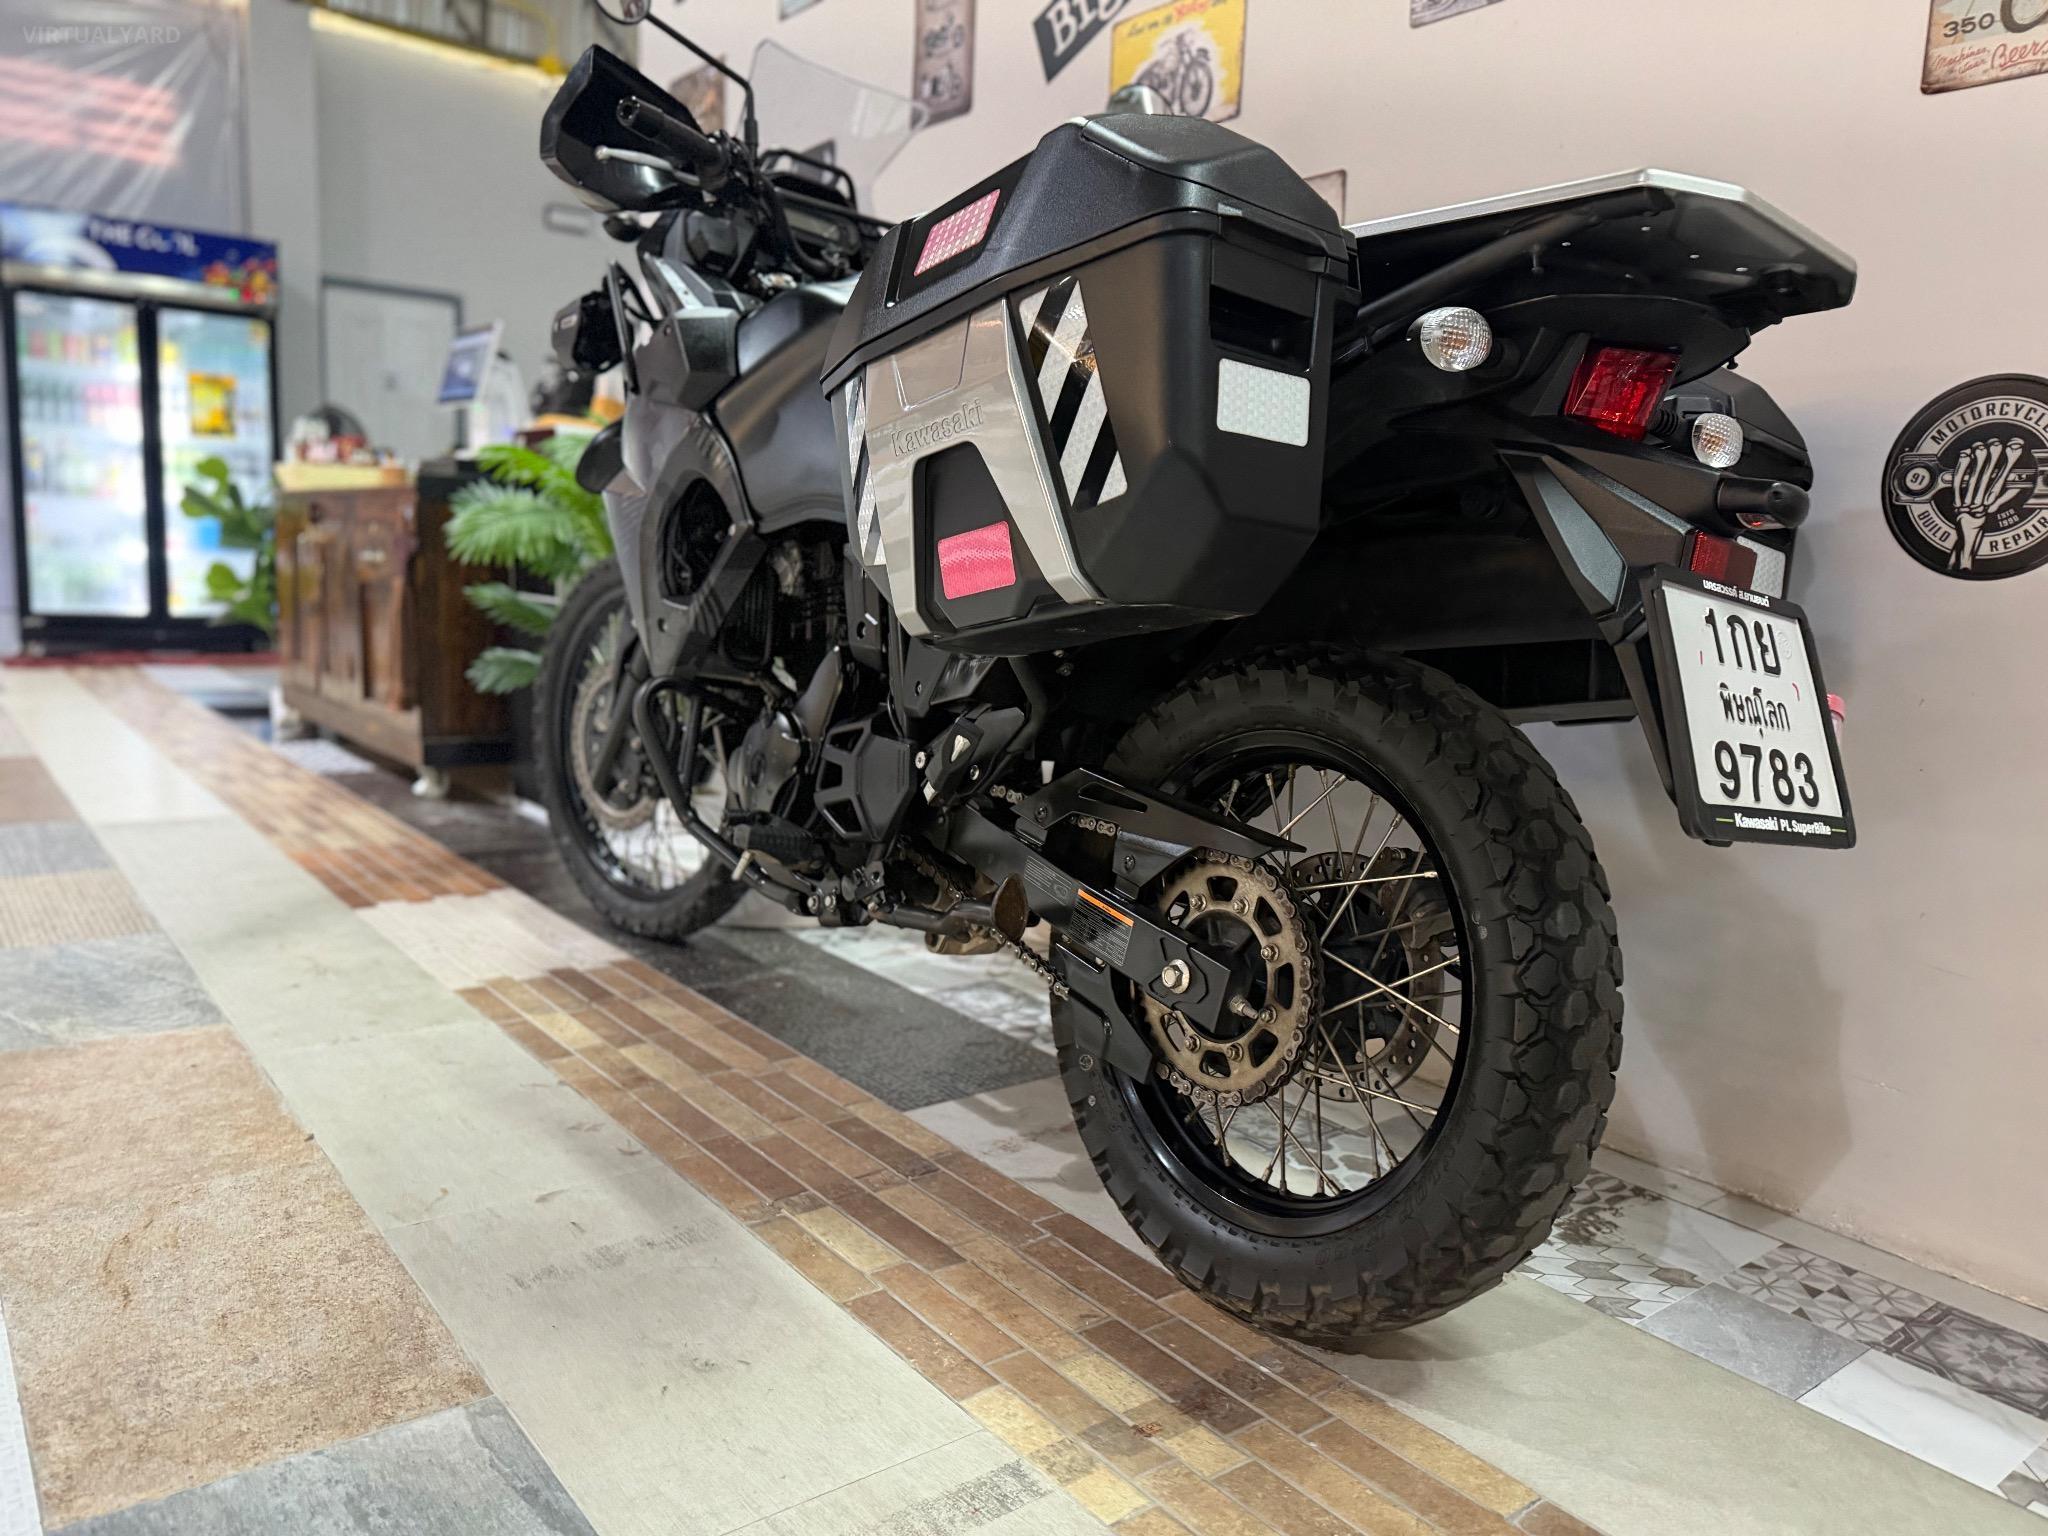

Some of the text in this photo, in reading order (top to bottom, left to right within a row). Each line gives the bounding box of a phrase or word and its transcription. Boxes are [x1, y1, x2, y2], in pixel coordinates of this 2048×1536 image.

[1943, 13, 1995, 38] 350
[891, 398, 984, 457] Kawasaki
[1918, 510, 1951, 543] BUILD
[1704, 608, 1781, 676] 1กย
[1719, 682, 1791, 738] พิษณุโลก
[1714, 740, 1820, 807] 9783
[1734, 812, 1779, 831] Kawasaki
[1792, 819, 1831, 836] SuperBike
